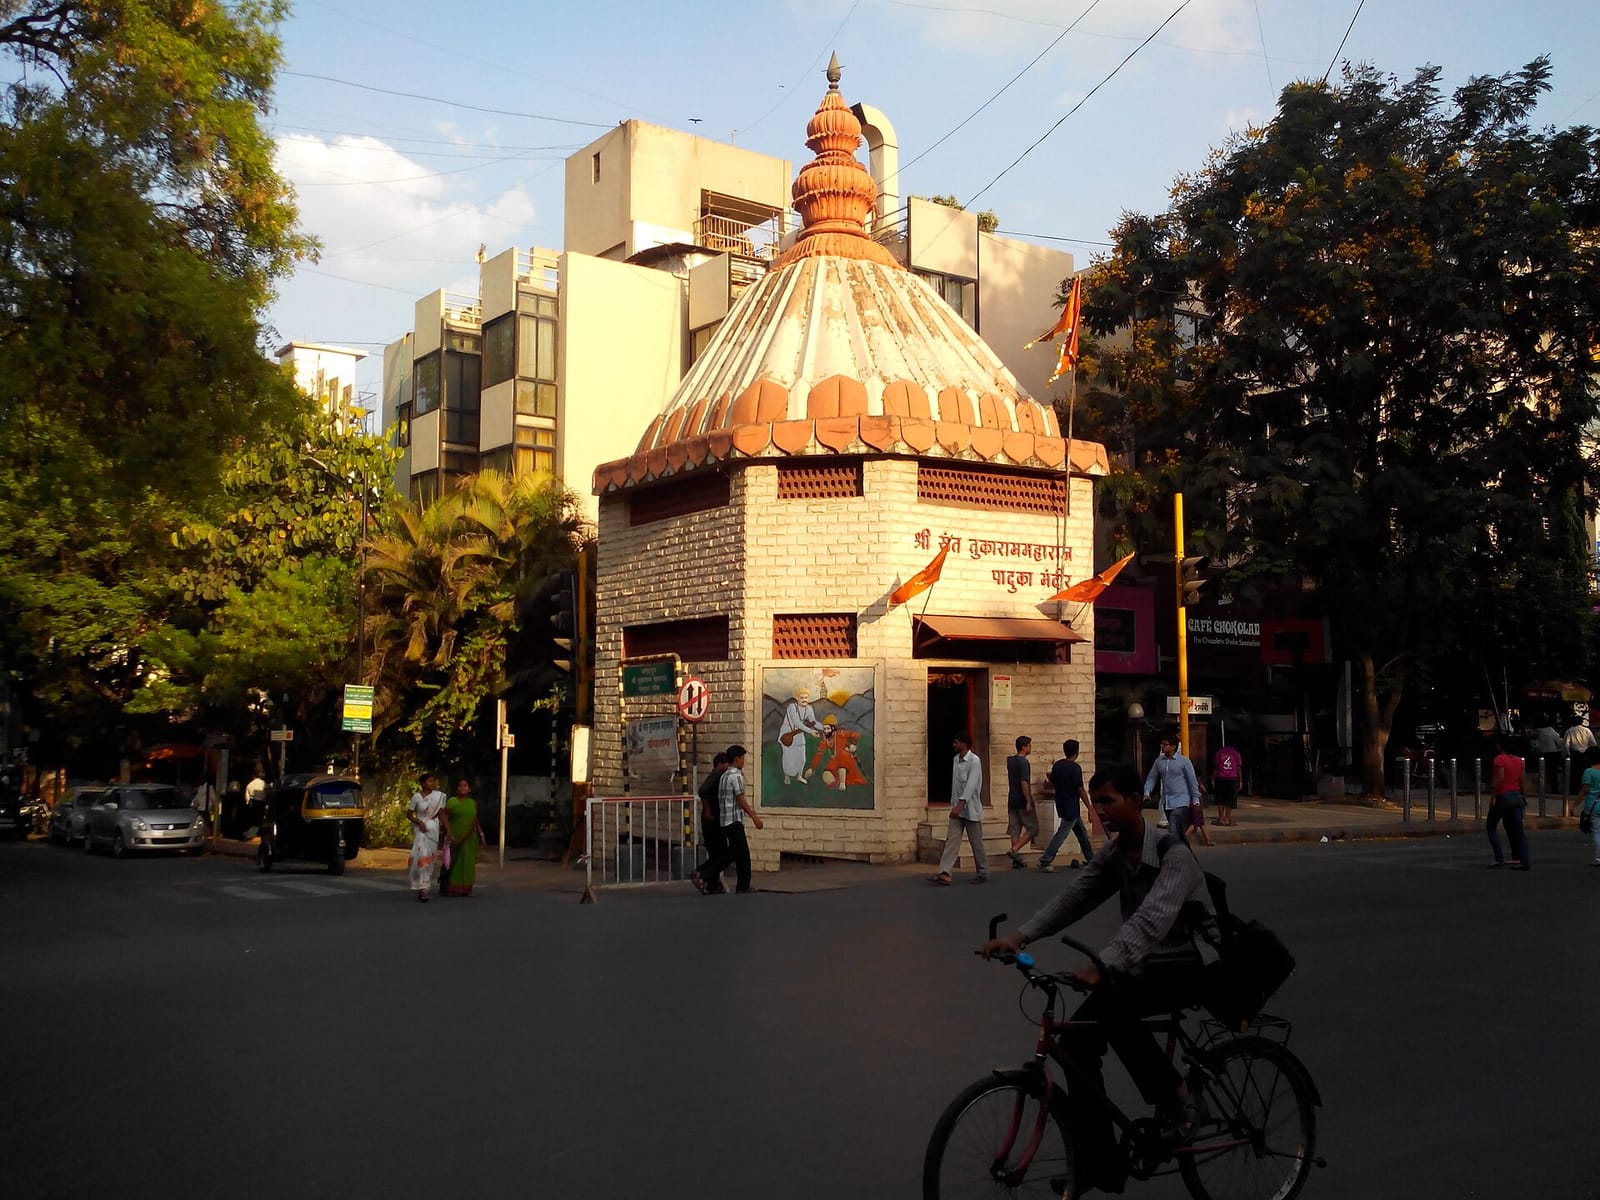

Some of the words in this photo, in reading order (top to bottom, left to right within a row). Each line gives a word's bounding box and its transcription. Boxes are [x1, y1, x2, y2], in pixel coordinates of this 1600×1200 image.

[914, 528, 931, 550] श्री
[991, 569, 1033, 593] पादुका
[1187, 616, 1212, 632] CAFÉ
[1223, 756, 1232, 768] 4
